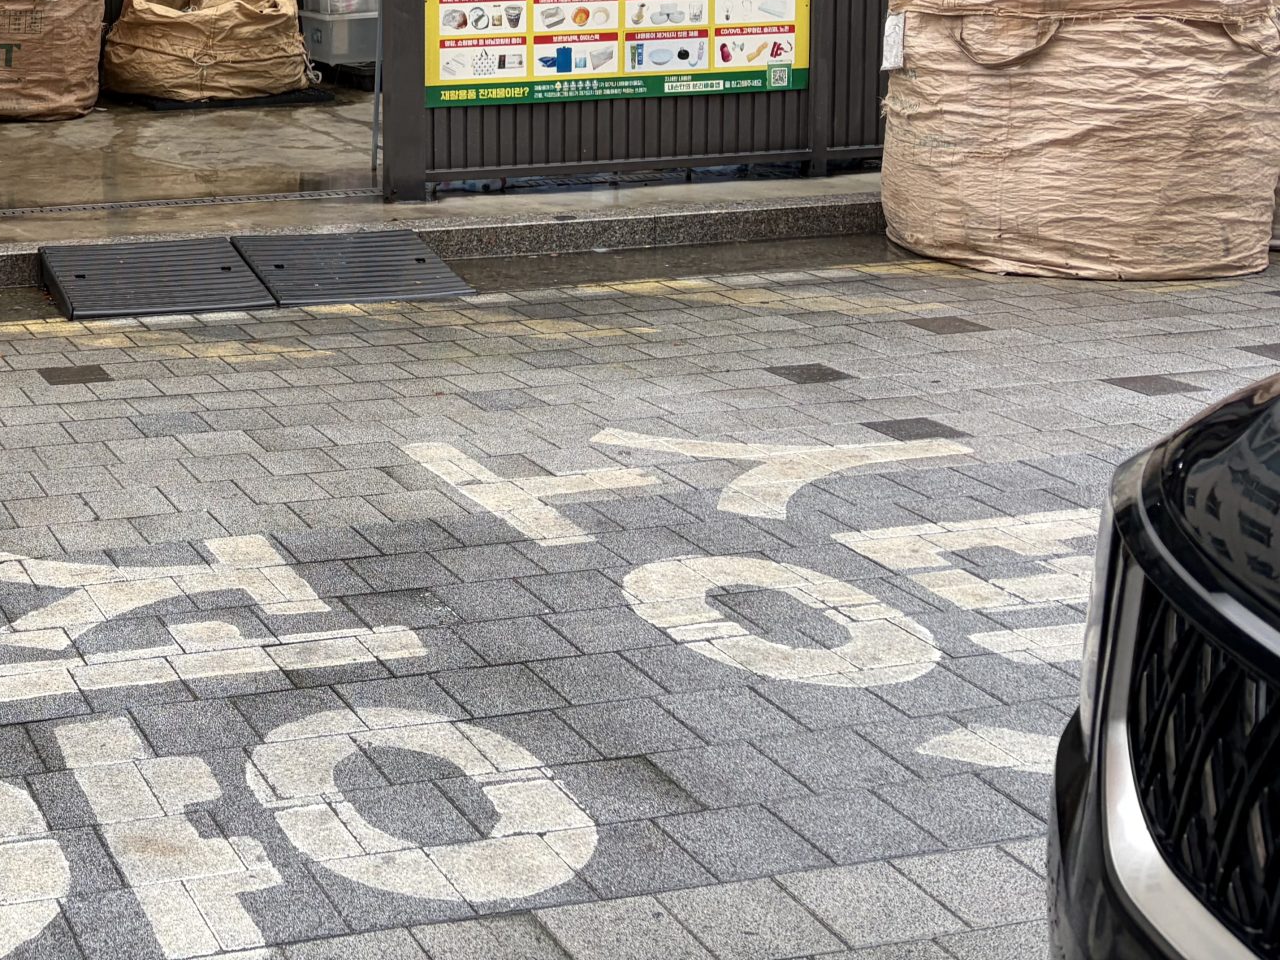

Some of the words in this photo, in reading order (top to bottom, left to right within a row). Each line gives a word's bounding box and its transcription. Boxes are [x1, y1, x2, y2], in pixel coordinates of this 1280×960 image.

[440, 90, 476, 100] 재활용품
[479, 87, 529, 100] 잔재물이란?
[404, 428, 1099, 773] 소방
